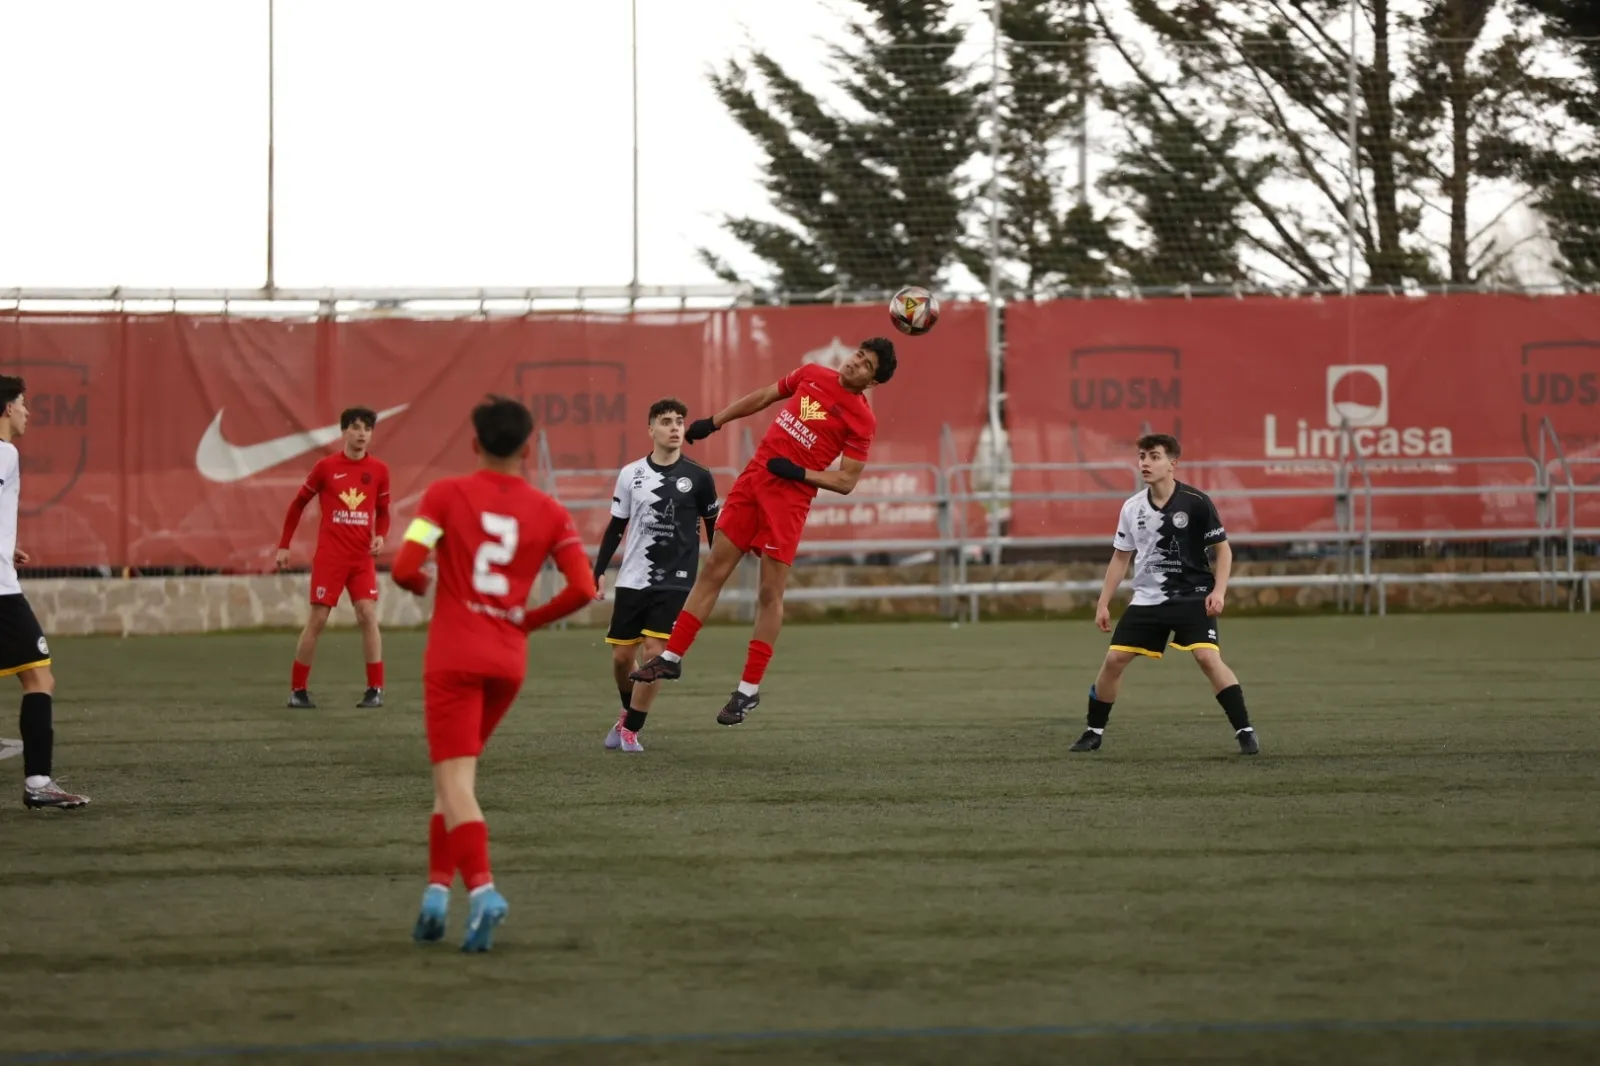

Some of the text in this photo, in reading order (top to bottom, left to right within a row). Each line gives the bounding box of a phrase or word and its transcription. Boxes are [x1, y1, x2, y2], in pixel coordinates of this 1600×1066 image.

[1071, 378, 1181, 410] UDSM
[1521, 373, 1599, 406] UDS
[31, 394, 88, 427] SM
[1264, 414, 1452, 458] Limcasa
[473, 511, 519, 597] 2
